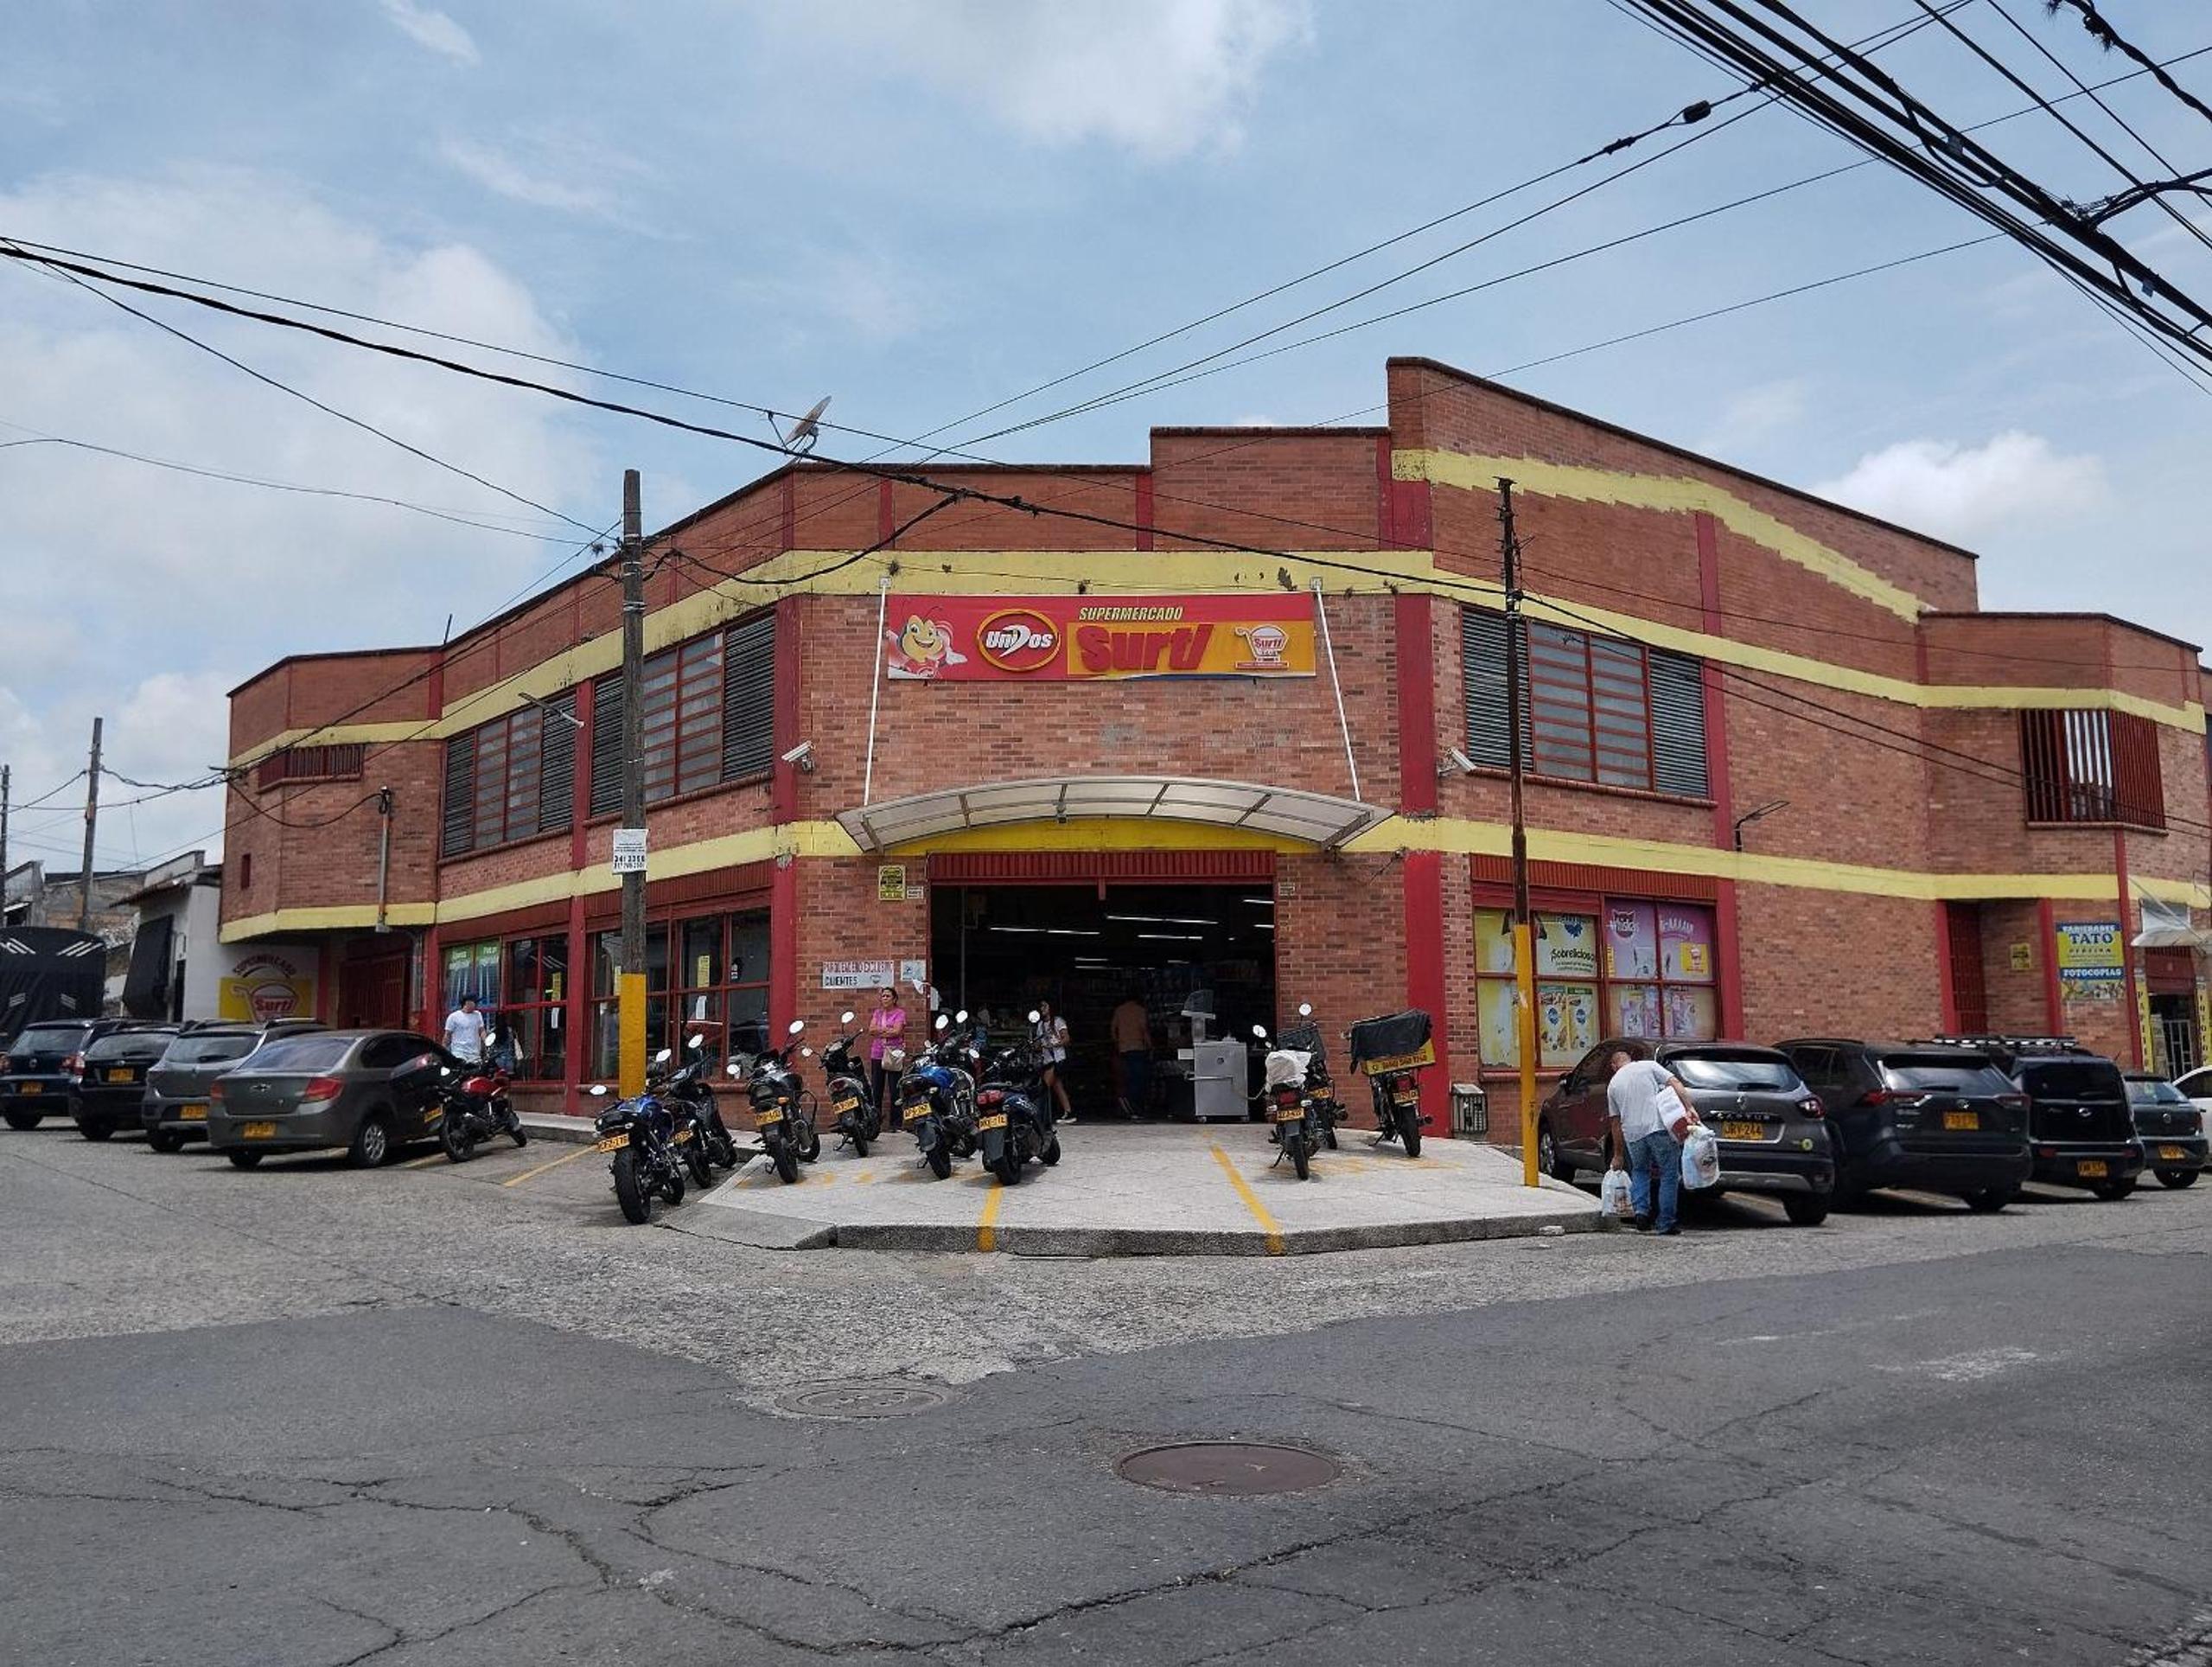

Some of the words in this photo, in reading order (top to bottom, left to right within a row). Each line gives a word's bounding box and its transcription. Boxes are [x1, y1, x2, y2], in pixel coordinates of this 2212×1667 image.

[1079, 607, 1184, 621] SUPERMERCADO
[1076, 623, 1214, 672] Surti
[2069, 933, 2113, 945] TATO
[2062, 968, 2122, 977] FOTOCOPIAS
[824, 975, 858, 987] CLIENTES
[253, 997, 295, 1012] Surti
